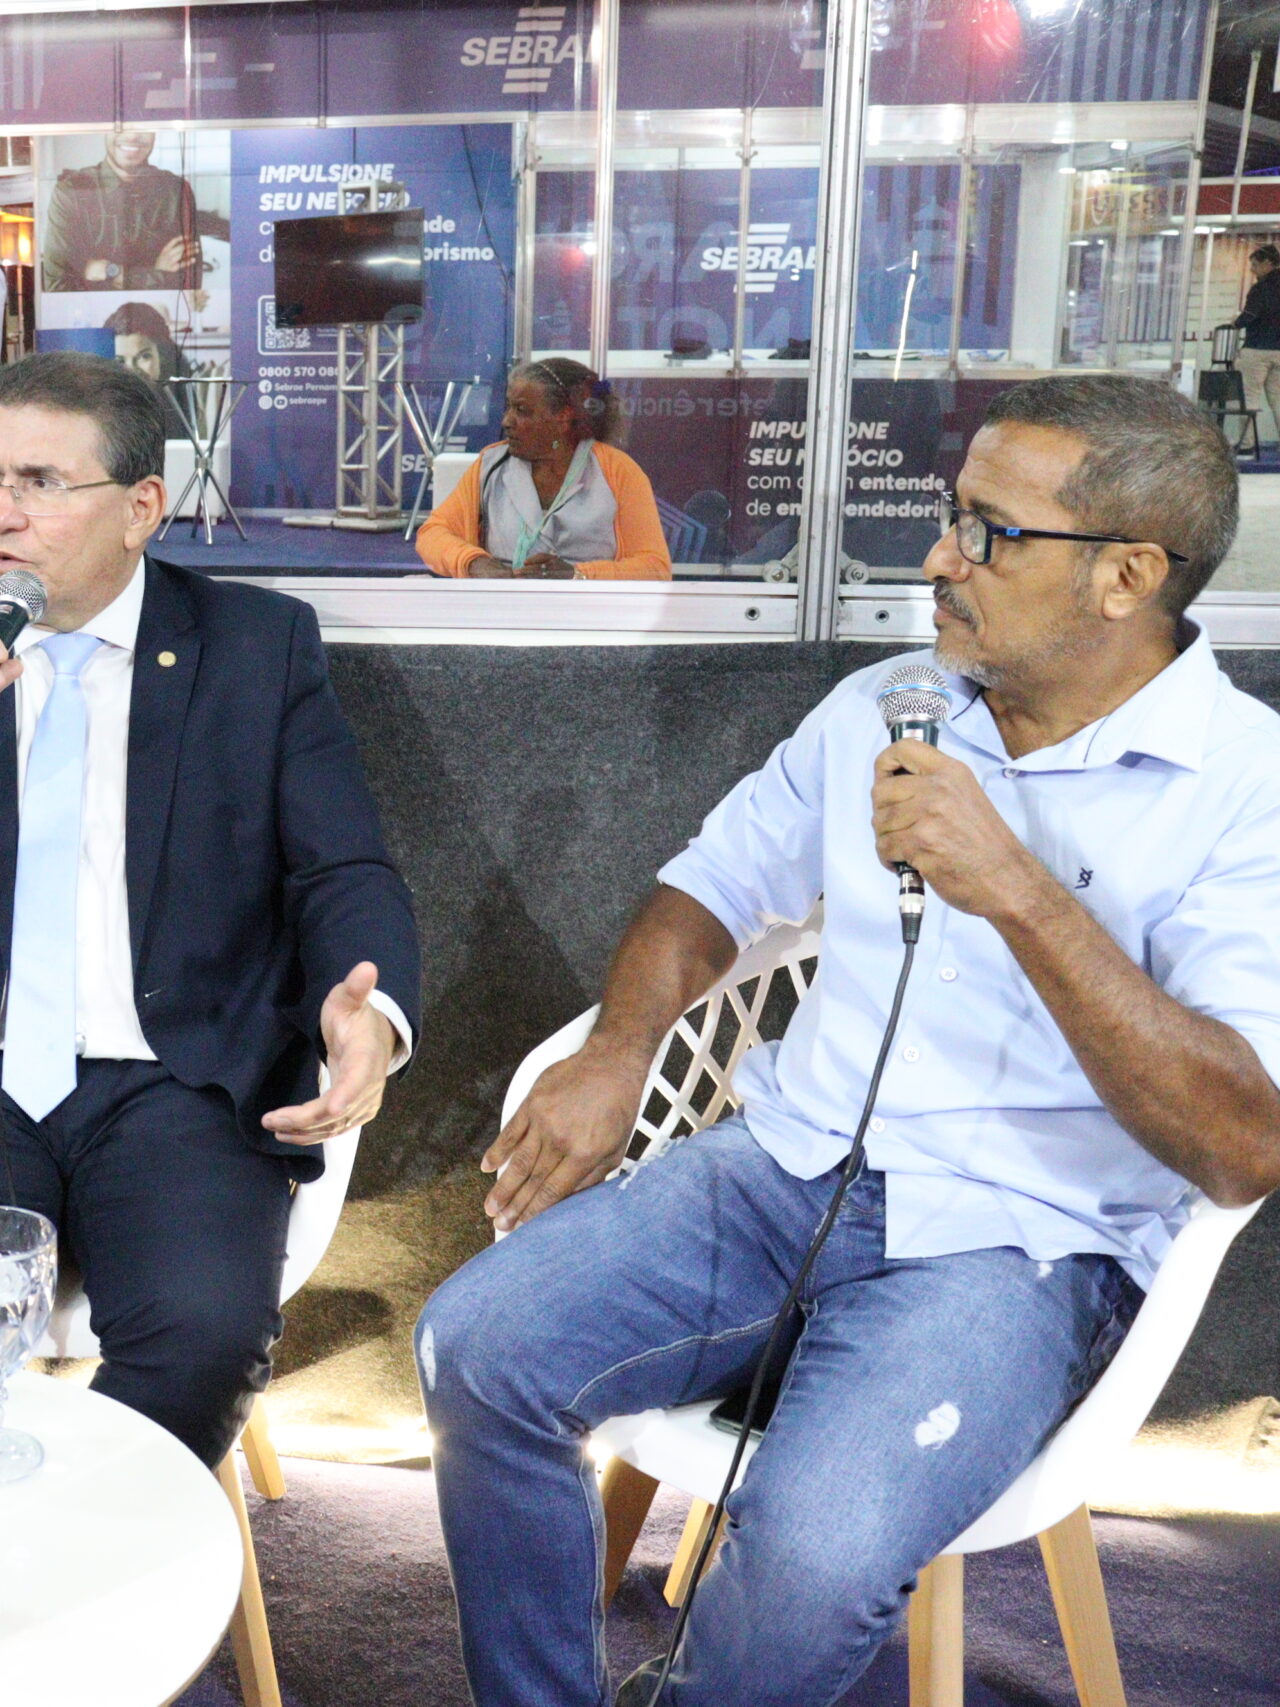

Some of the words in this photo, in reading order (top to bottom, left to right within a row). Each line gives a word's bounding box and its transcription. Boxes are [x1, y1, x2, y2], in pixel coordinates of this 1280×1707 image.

[258, 164, 395, 184] IMPULSIONE
[258, 192, 301, 211] SEU
[258, 367, 291, 377] 0800
[294, 367, 316, 377] 570
[274, 383, 303, 392] Sebrae
[749, 421, 890, 439] IMPUONE
[748, 449, 792, 466] SEU
[796, 445, 904, 467] NÓCIO
[747, 475, 791, 490] com
[859, 473, 946, 492] entende
[746, 499, 771, 516] de
